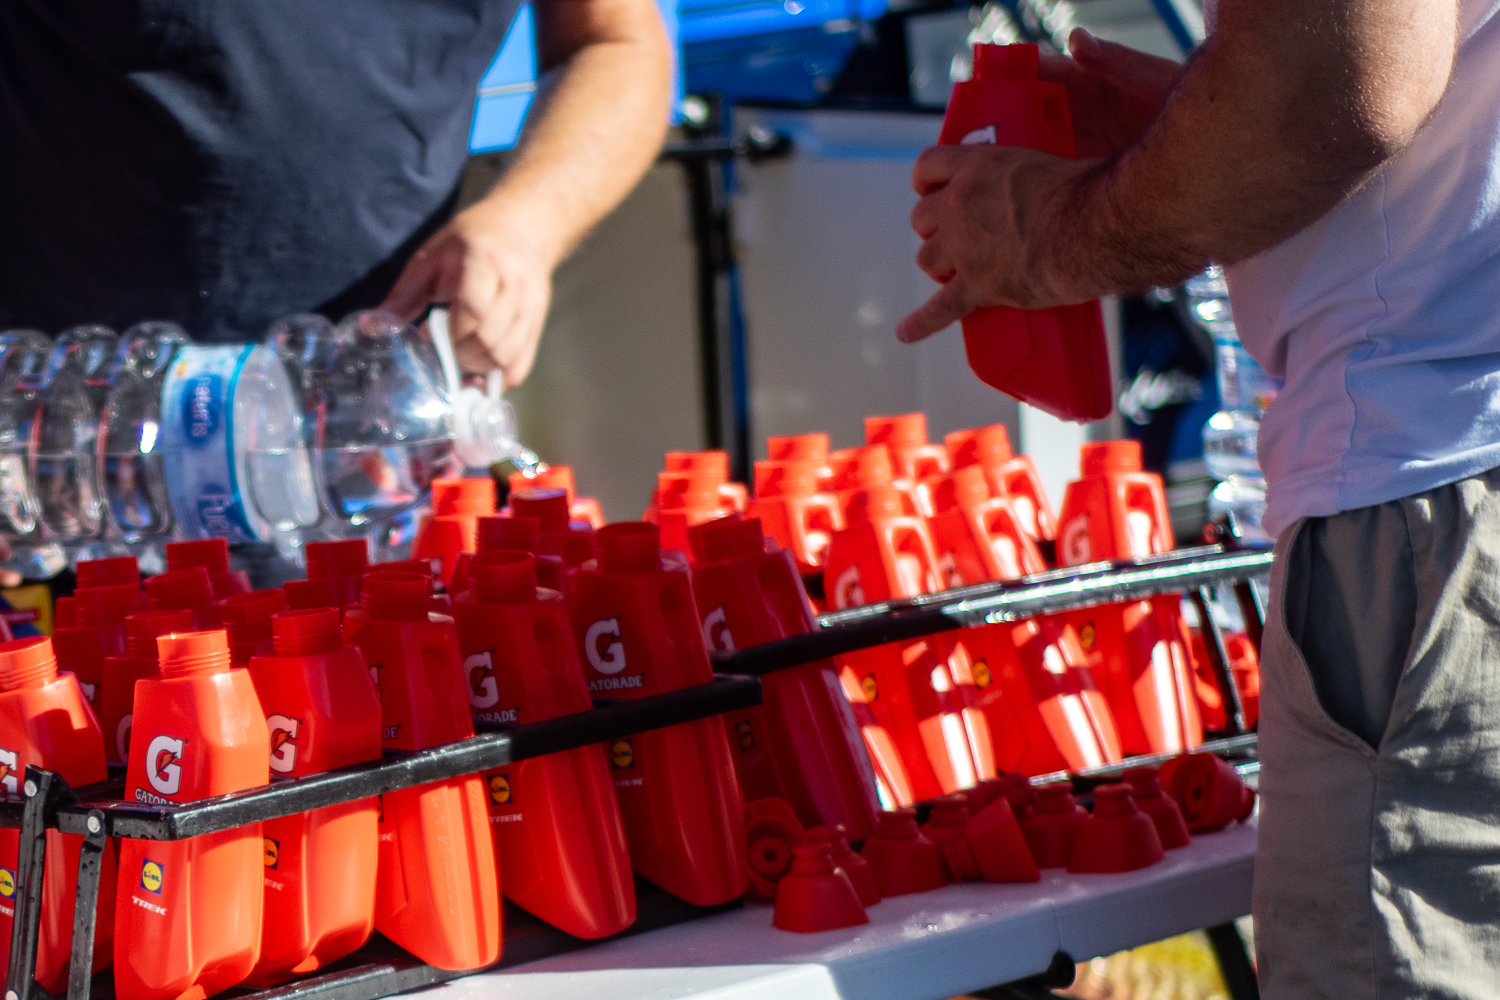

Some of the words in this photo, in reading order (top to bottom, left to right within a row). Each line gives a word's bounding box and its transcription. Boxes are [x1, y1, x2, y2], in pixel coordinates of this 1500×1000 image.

[584, 618, 627, 675] G
[462, 651, 500, 709] G
[146, 734, 185, 796] G
[267, 714, 299, 774] G
[132, 895, 168, 916] TREK
